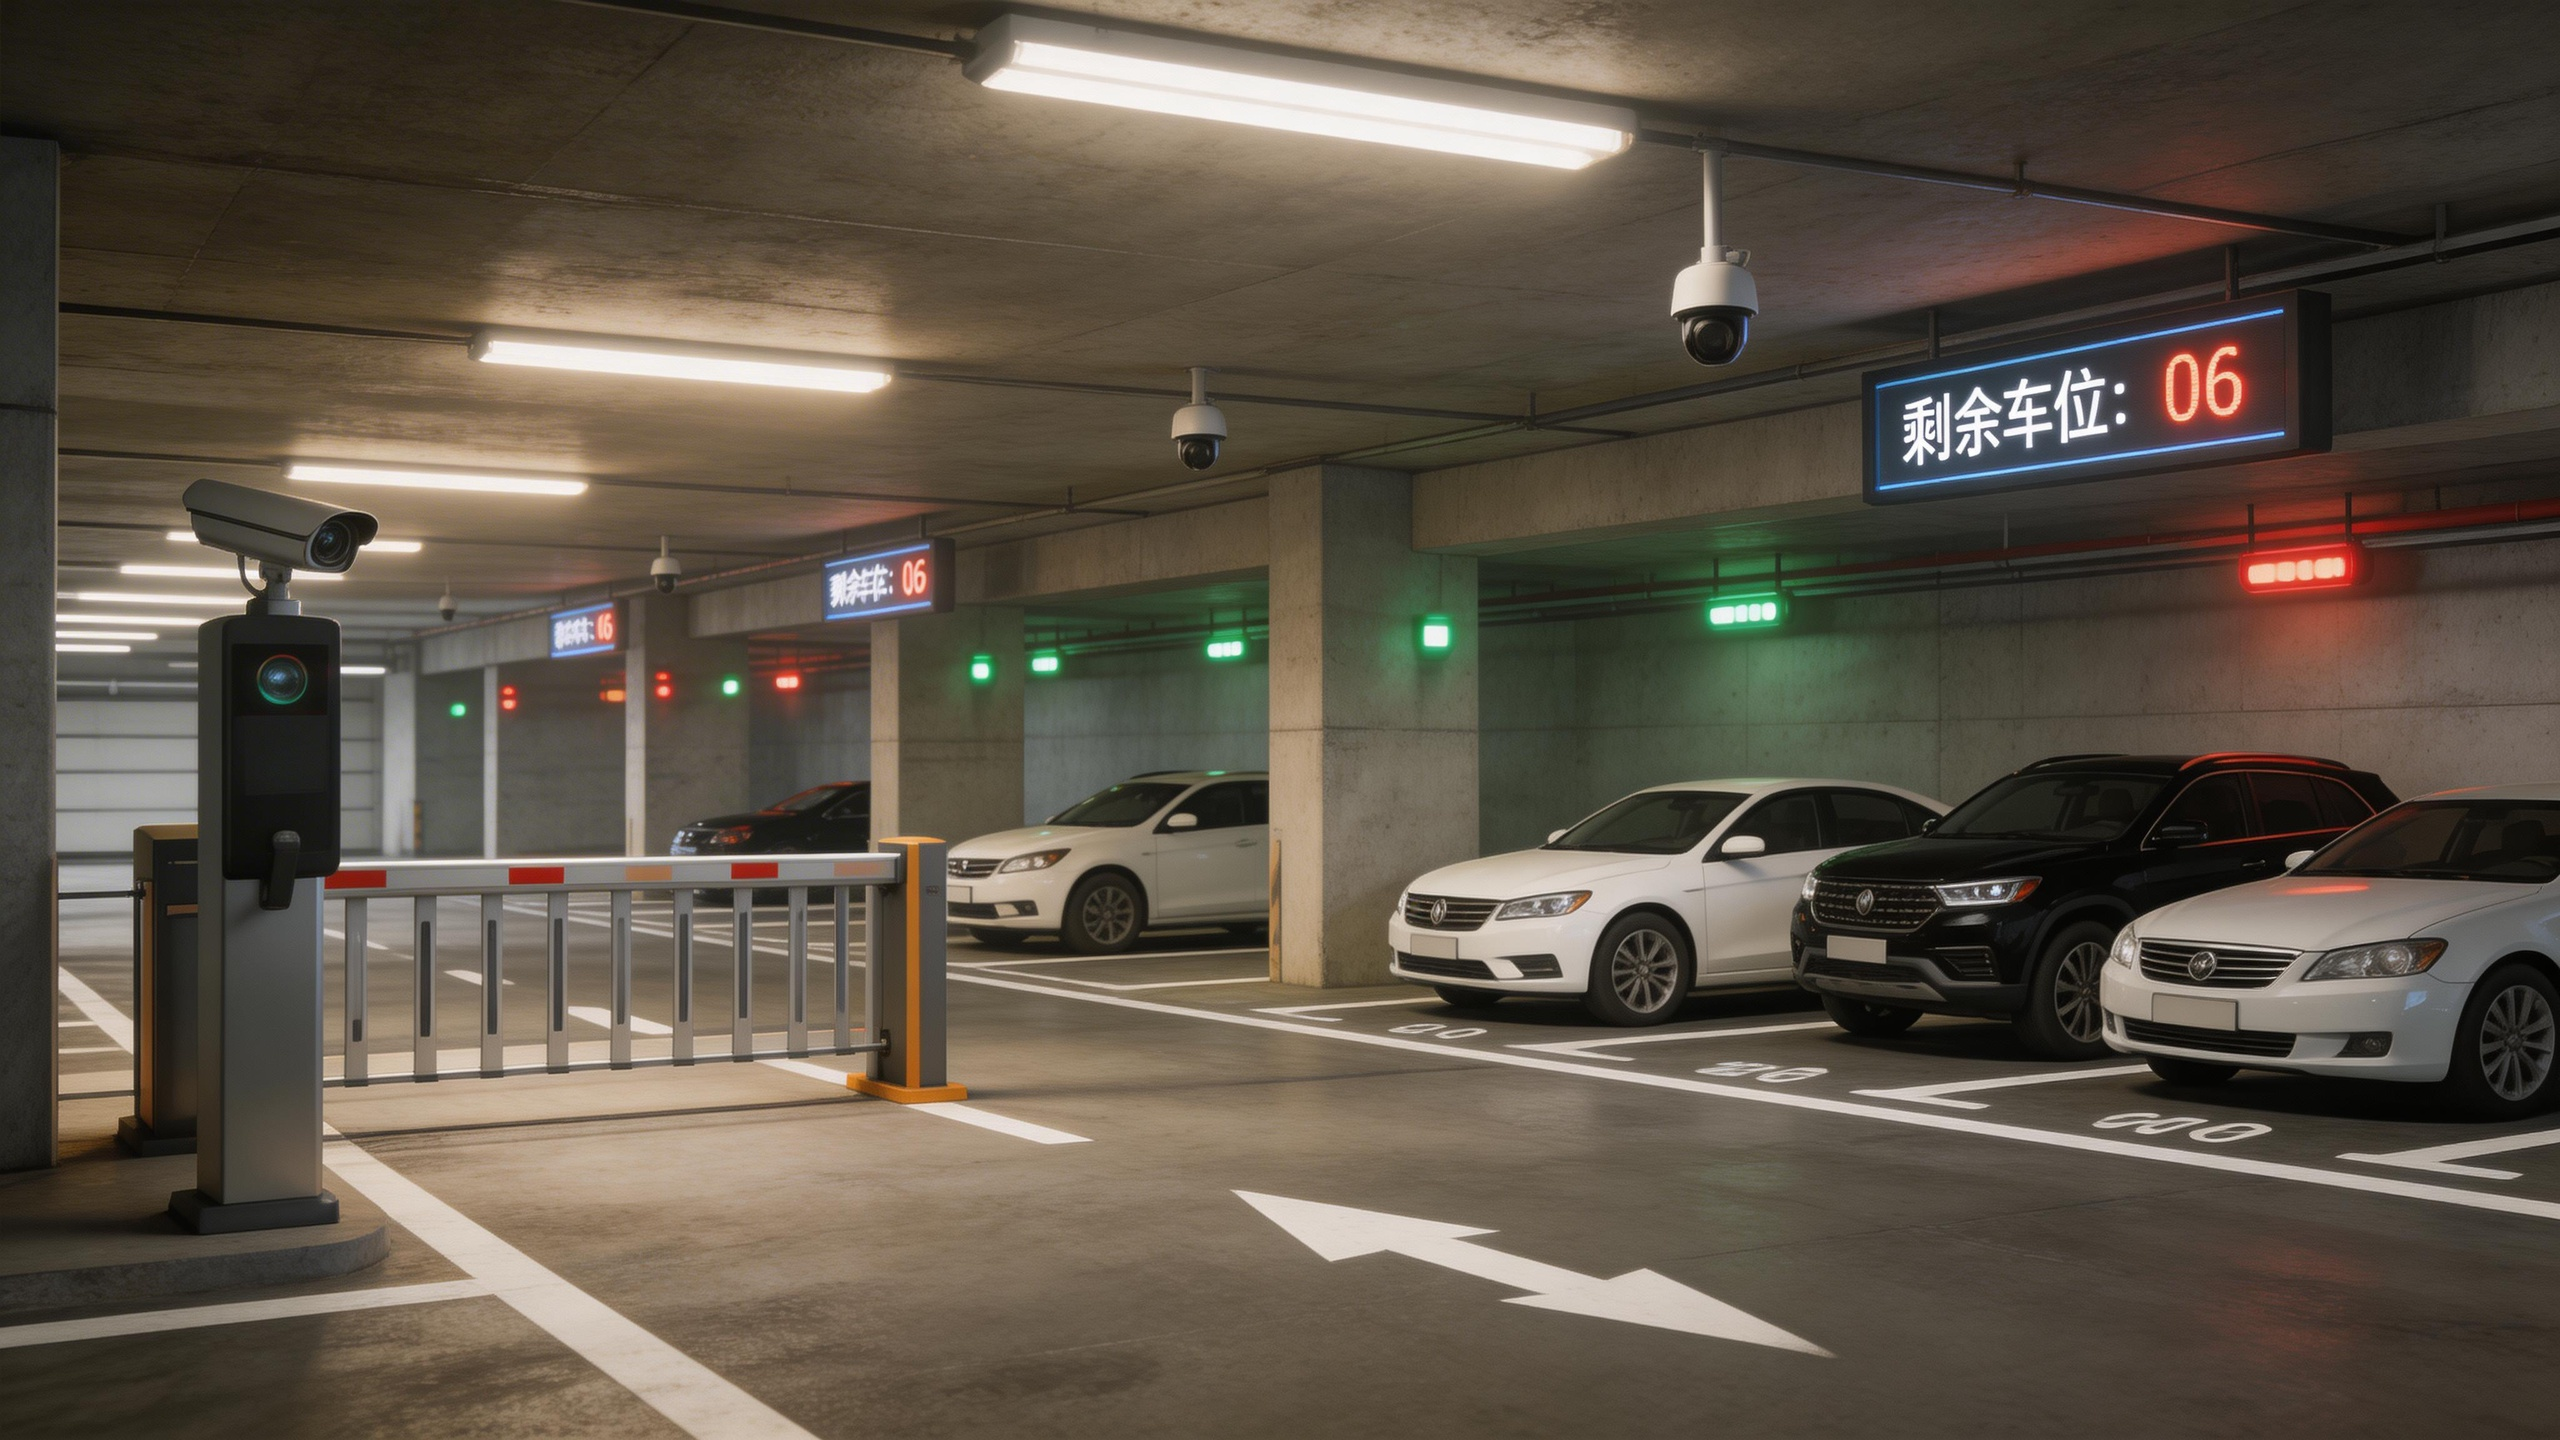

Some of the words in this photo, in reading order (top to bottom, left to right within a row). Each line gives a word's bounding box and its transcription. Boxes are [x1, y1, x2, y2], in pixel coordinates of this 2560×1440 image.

[1902, 368, 2125, 466] 剩余车位：
[2164, 345, 2244, 423] 06
[902, 559, 927, 596] 06
